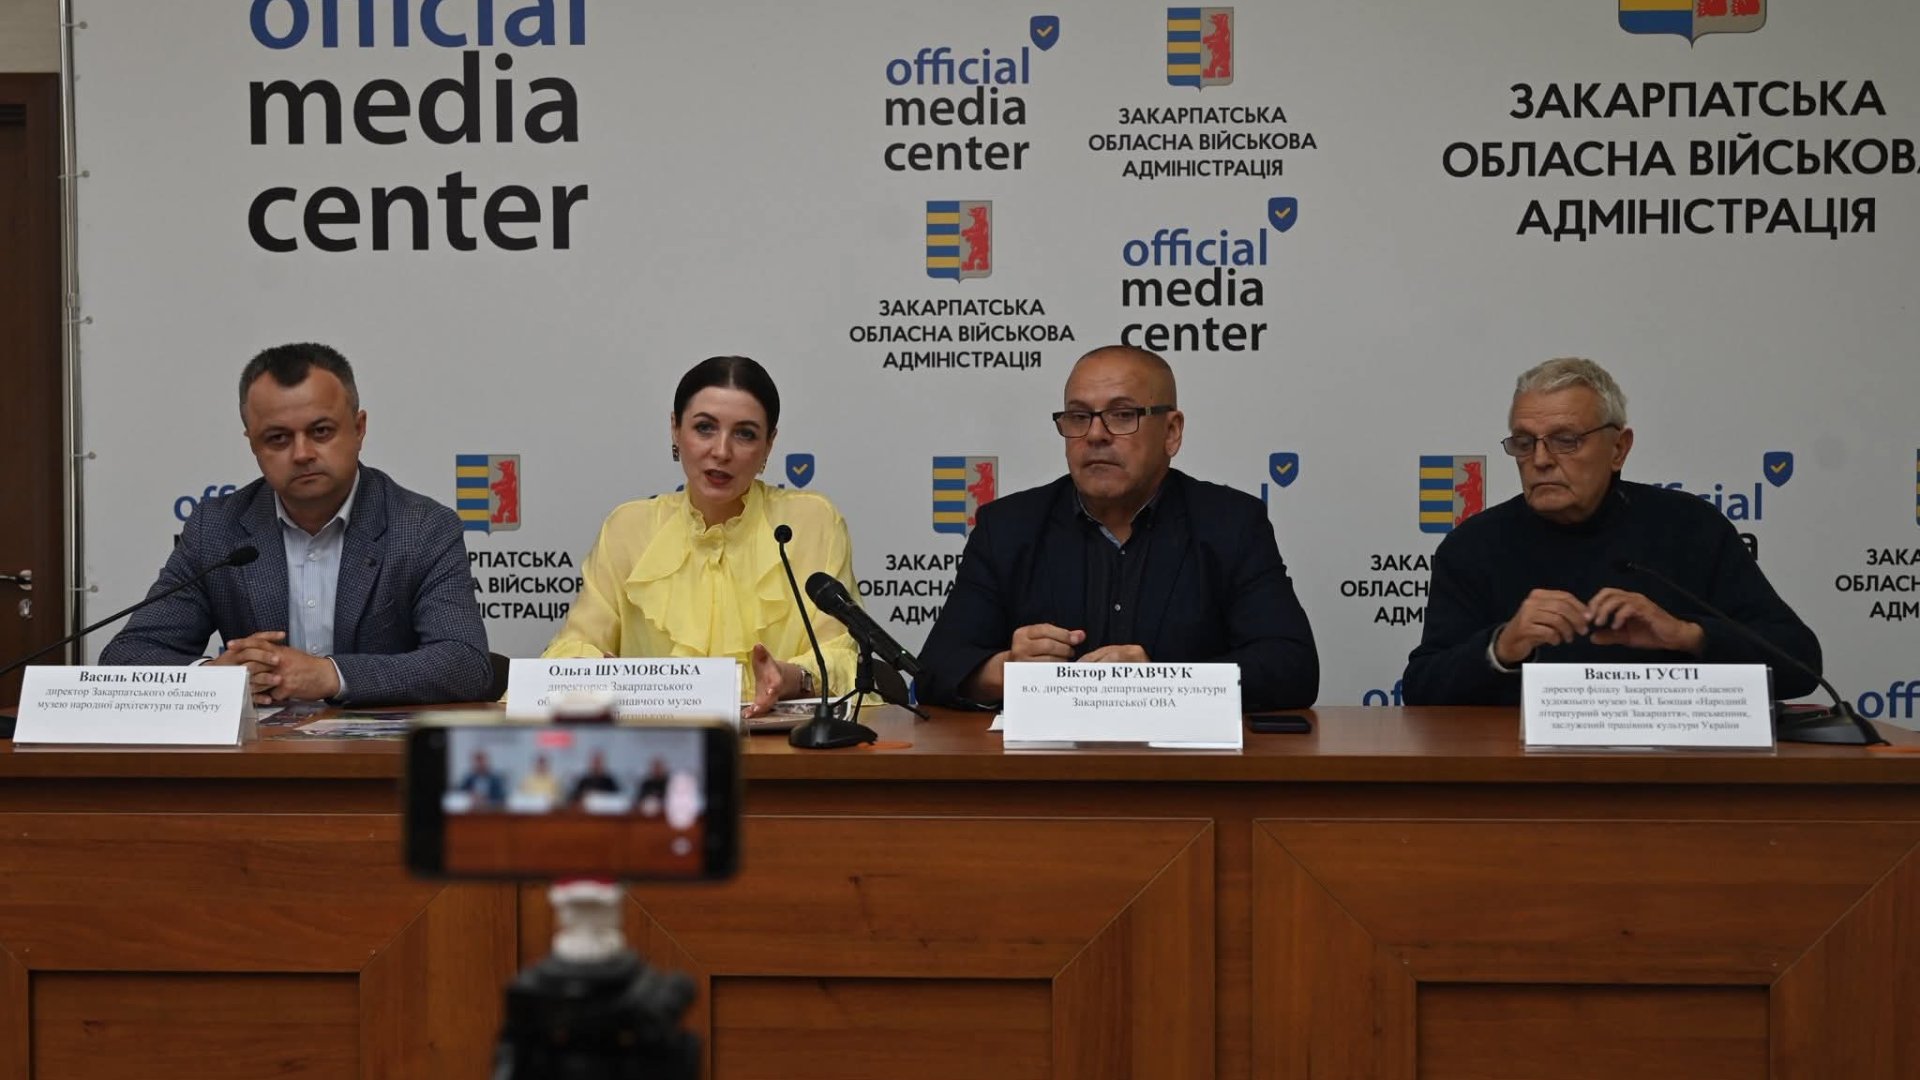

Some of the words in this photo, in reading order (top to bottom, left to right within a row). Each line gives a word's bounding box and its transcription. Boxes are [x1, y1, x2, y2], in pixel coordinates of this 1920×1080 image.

[887, 47, 1030, 86] official
[250, 51, 578, 144] media
[885, 86, 1027, 125] media
[1510, 80, 1886, 119] ЗАКАРПАТСЬКА
[1118, 107, 1288, 125] ЗАКАРПАТСЬКА
[1088, 133, 1194, 151] ОБЛАСНА
[1199, 131, 1318, 150] ВІЙСЬКОВА
[885, 136, 1030, 171] center
[1443, 141, 1676, 177] ОБЛАСНА
[1690, 133, 1920, 175] ВІЙСЬКОВ
[1122, 160, 1283, 180] АДМІНІСТРАЦІЯ
[248, 171, 588, 252] center
[1517, 198, 1876, 242] АДМІНІСТРАЦІЯ
[1123, 229, 1267, 266] official
[1122, 268, 1264, 307] media
[879, 299, 1046, 316] ЗАКАРПАТСЬКА
[849, 325, 952, 343] ОБЛАСНА
[959, 322, 1075, 342] ВІЙСЬКОВА
[1121, 317, 1268, 352] center
[882, 351, 1042, 371] АДМІНІСТРАЦІЯ
[79, 671, 127, 683] Василь
[131, 671, 188, 685] КОЦАН
[548, 665, 591, 677] Ольга
[595, 664, 702, 676] ШУМОВСЬКА
[1056, 666, 1107, 680] Віктор
[1111, 666, 1193, 679] КРАВЧУК
[1585, 668, 1641, 681] Василь
[1645, 667, 1700, 680] ГУСТІ
[45, 687, 90, 698] директор
[92, 687, 165, 699] Закарпатського
[167, 687, 217, 698] обласного
[547, 682, 608, 693] директорка
[611, 682, 693, 693] Закарпатського
[1022, 685, 1040, 693] в.о.
[1043, 685, 1098, 695] директора
[1101, 685, 1174, 695] департаменту
[1177, 685, 1227, 695] культури
[1542, 686, 1585, 695] директор
[1624, 686, 1694, 695] Закарпатського
[1696, 685, 1744, 694] обласного
[37, 702, 68, 711] музею
[70, 701, 113, 711] народної
[115, 702, 172, 712] архітектури
[186, 702, 221, 713] побуту
[667, 698, 702, 708] музею
[1072, 697, 1147, 708] Закарпатської
[1150, 698, 1177, 708] ОВА
